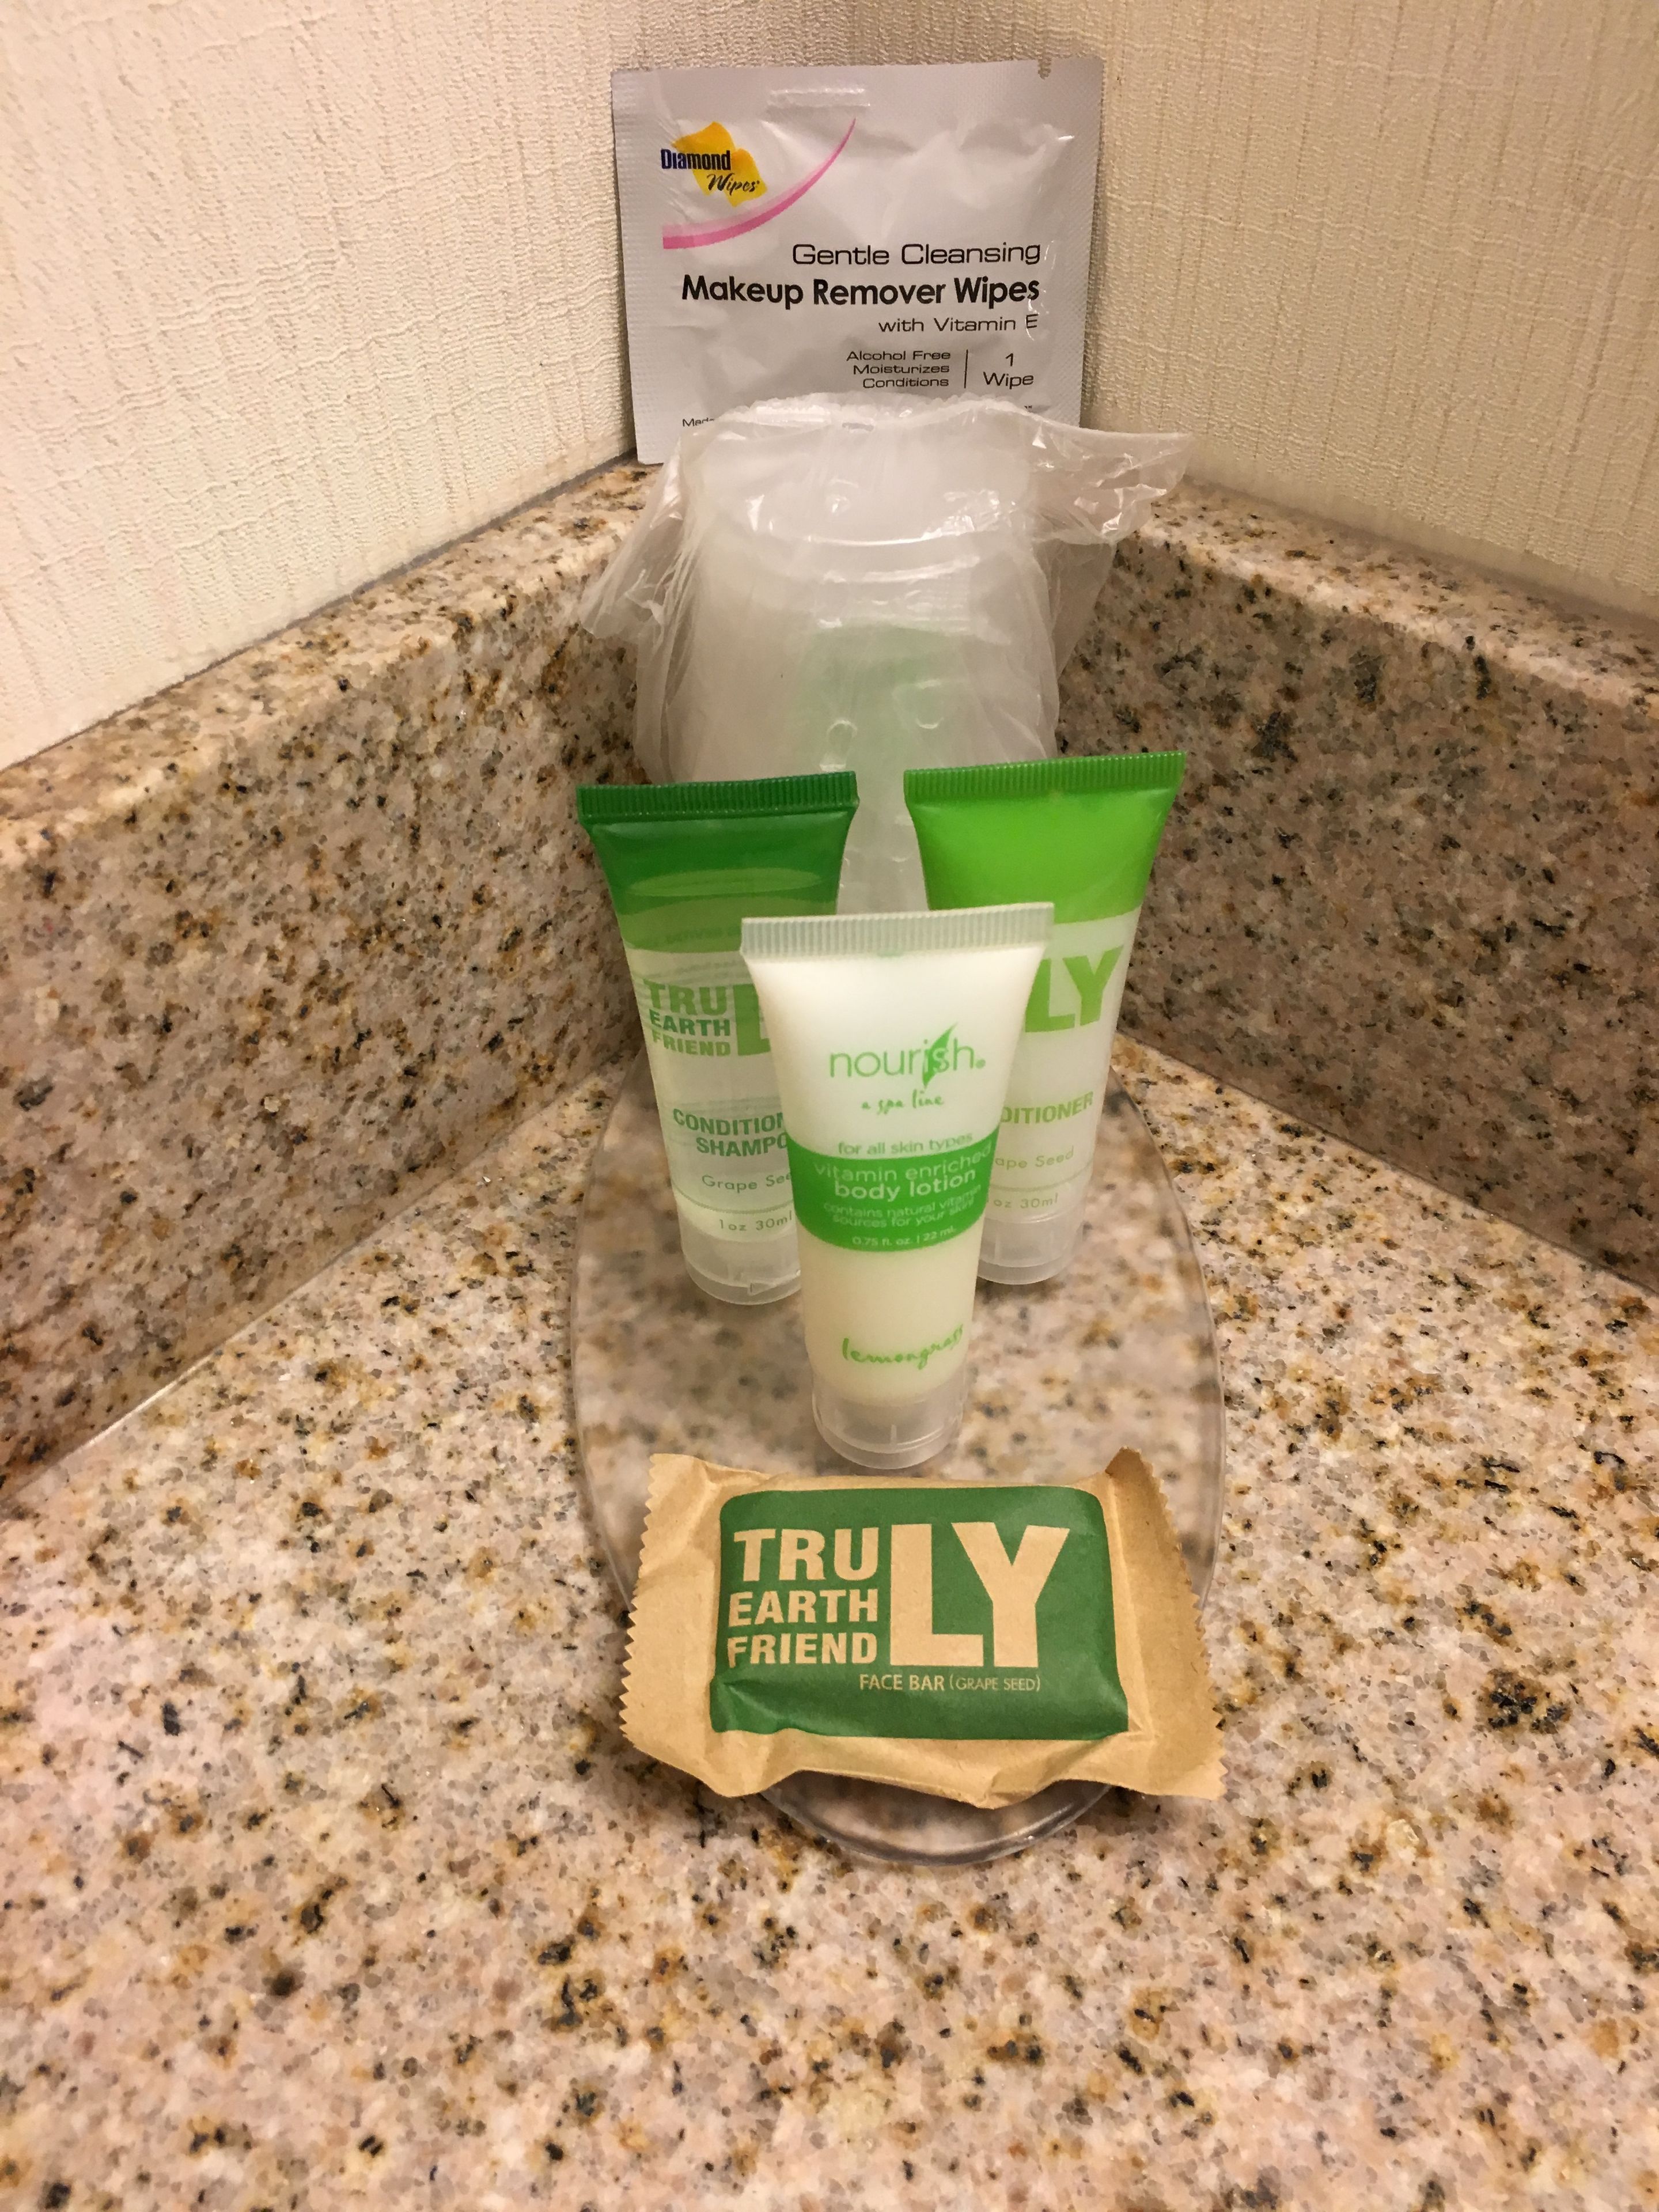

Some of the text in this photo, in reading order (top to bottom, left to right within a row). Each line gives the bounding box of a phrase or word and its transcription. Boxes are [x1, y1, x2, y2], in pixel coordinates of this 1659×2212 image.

[661, 149, 732, 171] Diamond
[793, 241, 1040, 265] Gentle Cleansing
[682, 274, 1040, 310] Makeup Remover Wipes
[878, 314, 1039, 332] with Vitamin E
[846, 350, 951, 361] Alcohol Free
[1005, 353, 1014, 367] 1
[853, 364, 950, 375] Moisturizes
[863, 377, 949, 389] Conditions
[983, 372, 1035, 389] Wipe
[649, 1009, 730, 1036] EARTH
[652, 1029, 731, 1056] FRIEND
[830, 1036, 975, 1080] nourish
[877, 1100, 903, 1115] spa
[912, 1089, 944, 1109] line
[838, 1133, 973, 1154] for all skin types
[814, 1139, 992, 1182] vitamin enriched
[1035, 1145, 1074, 1167] Seed
[702, 1175, 758, 1194] Grape
[835, 1169, 976, 1202] body lotion
[824, 1202, 883, 1218] contains
[888, 1202, 935, 1218] natural
[993, 1192, 1058, 1209] oz 30ml
[755, 1210, 793, 1231] 30ml
[832, 1214, 887, 1228] sources
[892, 1216, 910, 1228] for
[916, 1211, 945, 1226] your
[923, 1231, 937, 1241] 22
[728, 1588, 878, 1627] EARTH
[727, 1631, 878, 1668] FRIEND
[859, 1673, 1041, 1692] FACE BAR (GRAPE SEED)
